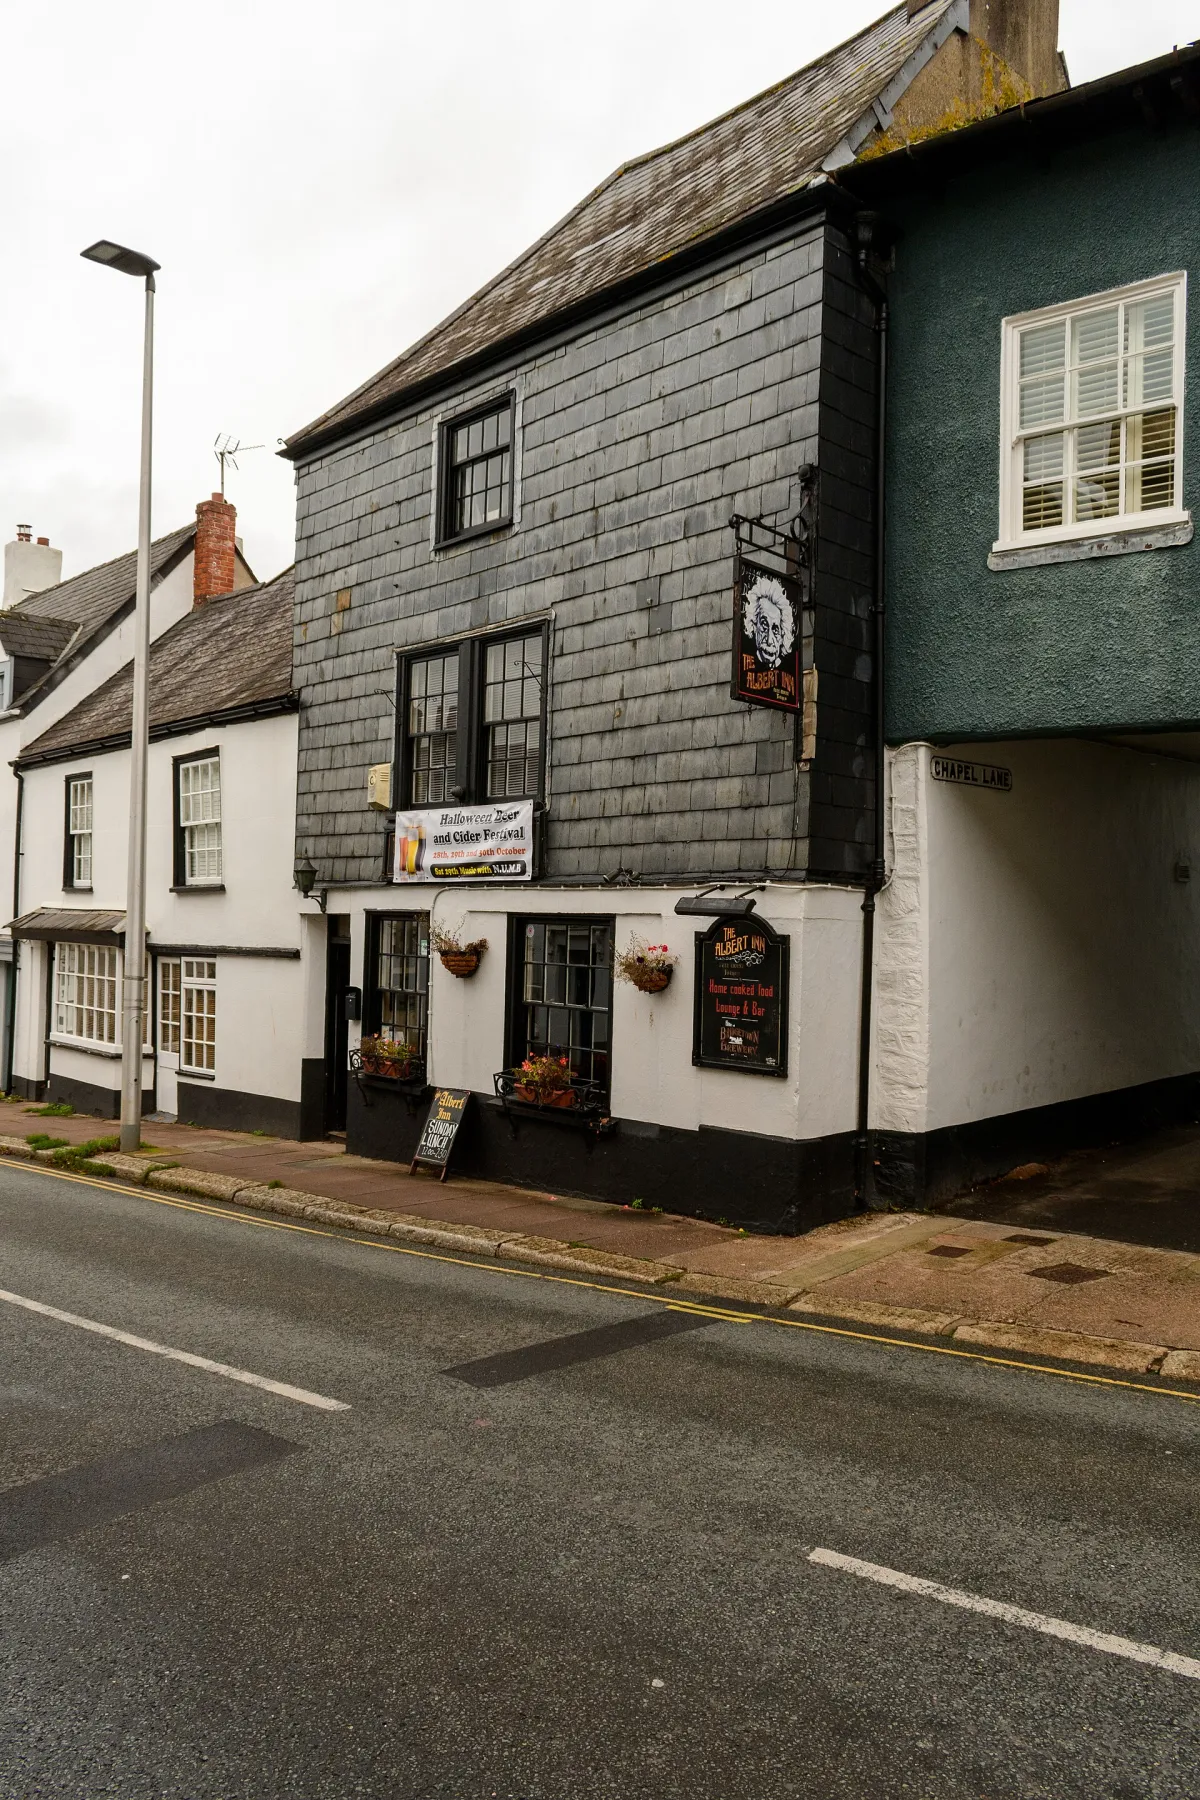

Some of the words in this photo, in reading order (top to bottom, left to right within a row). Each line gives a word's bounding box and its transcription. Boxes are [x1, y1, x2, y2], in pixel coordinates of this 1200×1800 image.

[743, 653, 755, 670] THE
[746, 669, 779, 690] ALBERT
[781, 671, 795, 696] INN
[934, 760, 977, 782] CHAPEL
[983, 768, 1010, 787] LANE
[440, 813, 492, 826] Halloween
[494, 810, 519, 823] Beer
[433, 831, 452, 845] and
[453, 831, 481, 844] Cider
[483, 826, 525, 841] Festival
[433, 850, 449, 859] 28th,
[450, 849, 464, 858] 29th
[466, 848, 478, 857] and
[479, 848, 494, 857] 30th
[496, 846, 526, 855] October
[434, 867, 444, 875] Sat
[460, 866, 476, 875] Music
[477, 865, 492, 874] with
[723, 927, 736, 942] THE
[715, 935, 749, 956] ALBERT
[751, 935, 766, 955] INN
[709, 978, 728, 994] Home
[730, 984, 755, 996] cooked
[715, 997, 741, 1017] Lounge
[743, 1000, 749, 1015] &
[752, 1001, 766, 1017] Bar
[437, 1091, 466, 1109] Albert
[436, 1108, 451, 1120] Inn
[428, 1120, 459, 1139] SUNDAY
[421, 1133, 449, 1149] LUNCH
